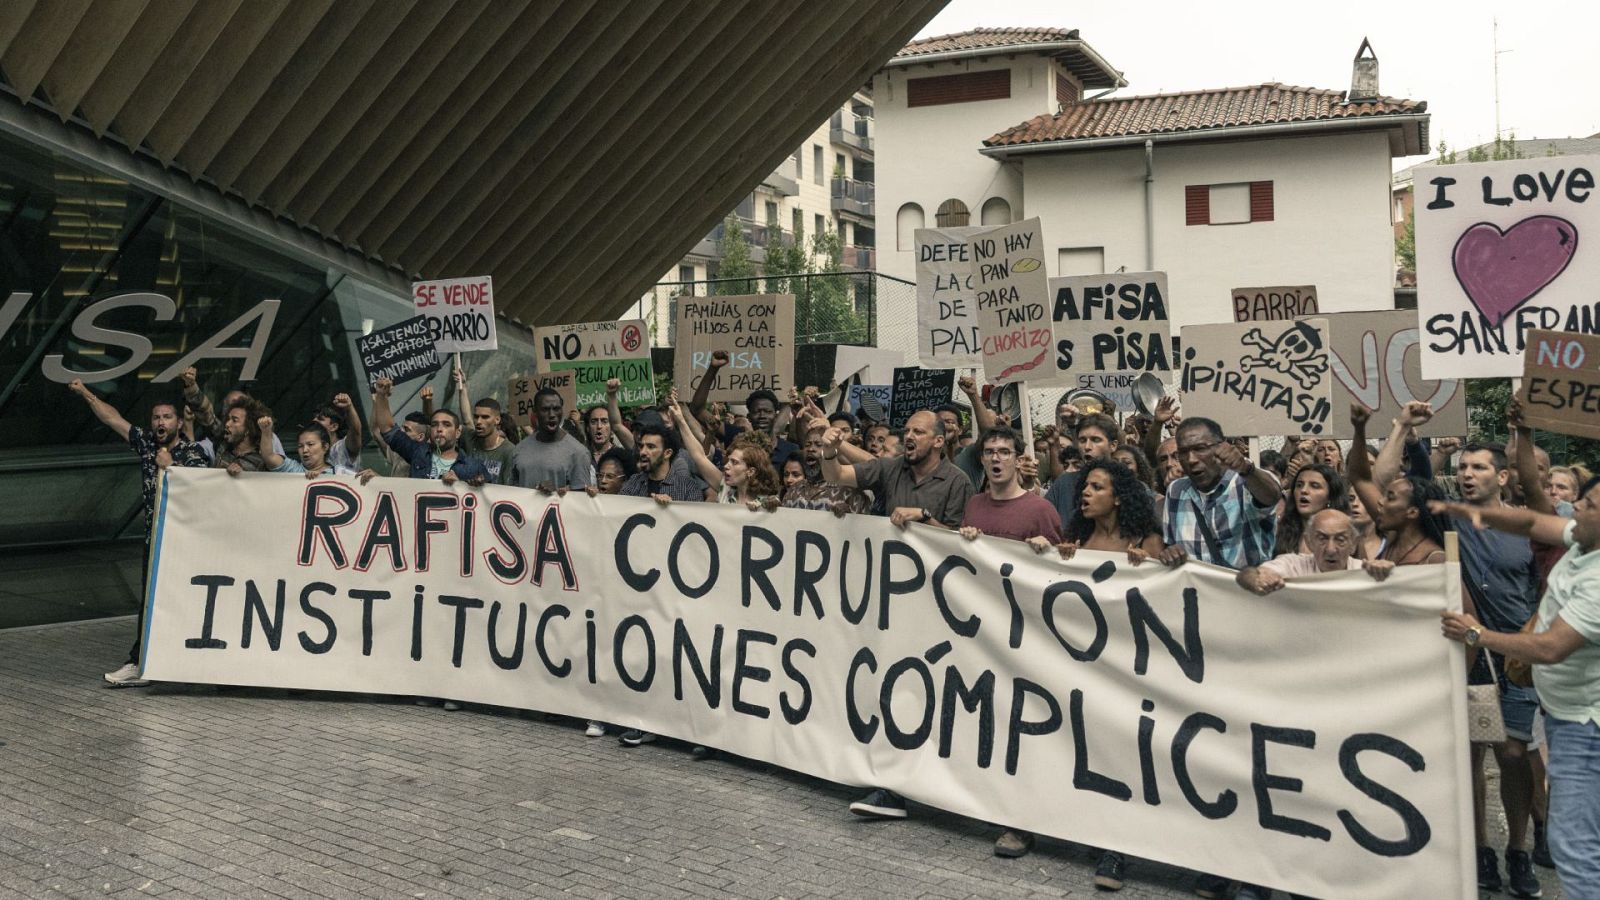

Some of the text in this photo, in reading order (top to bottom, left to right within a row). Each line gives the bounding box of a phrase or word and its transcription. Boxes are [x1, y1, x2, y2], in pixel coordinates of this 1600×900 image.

[920, 243, 969, 262] DEFE
[974, 232, 1033, 262] NO HAY
[980, 259, 1009, 284] PAN
[416, 283, 490, 307] SE VENDE
[933, 273, 960, 298] LA
[939, 300, 967, 320] DE
[977, 286, 1020, 310] PARA
[747, 304, 776, 317] CON
[995, 303, 1044, 327] TANTO
[361, 319, 428, 353] ASALTEMOS
[733, 319, 743, 332] A
[748, 320, 768, 332] LA
[1426, 311, 1510, 355] SAN
[543, 333, 617, 361] NO A LA
[1537, 339, 1586, 370] NO
[364, 354, 382, 367] EL
[692, 351, 762, 369] RAISA
[515, 375, 571, 396] SE VENDE
[898, 371, 905, 382] A
[898, 378, 933, 391] ESTAS
[1079, 375, 1095, 389] SE
[1528, 378, 1600, 415] ESPE
